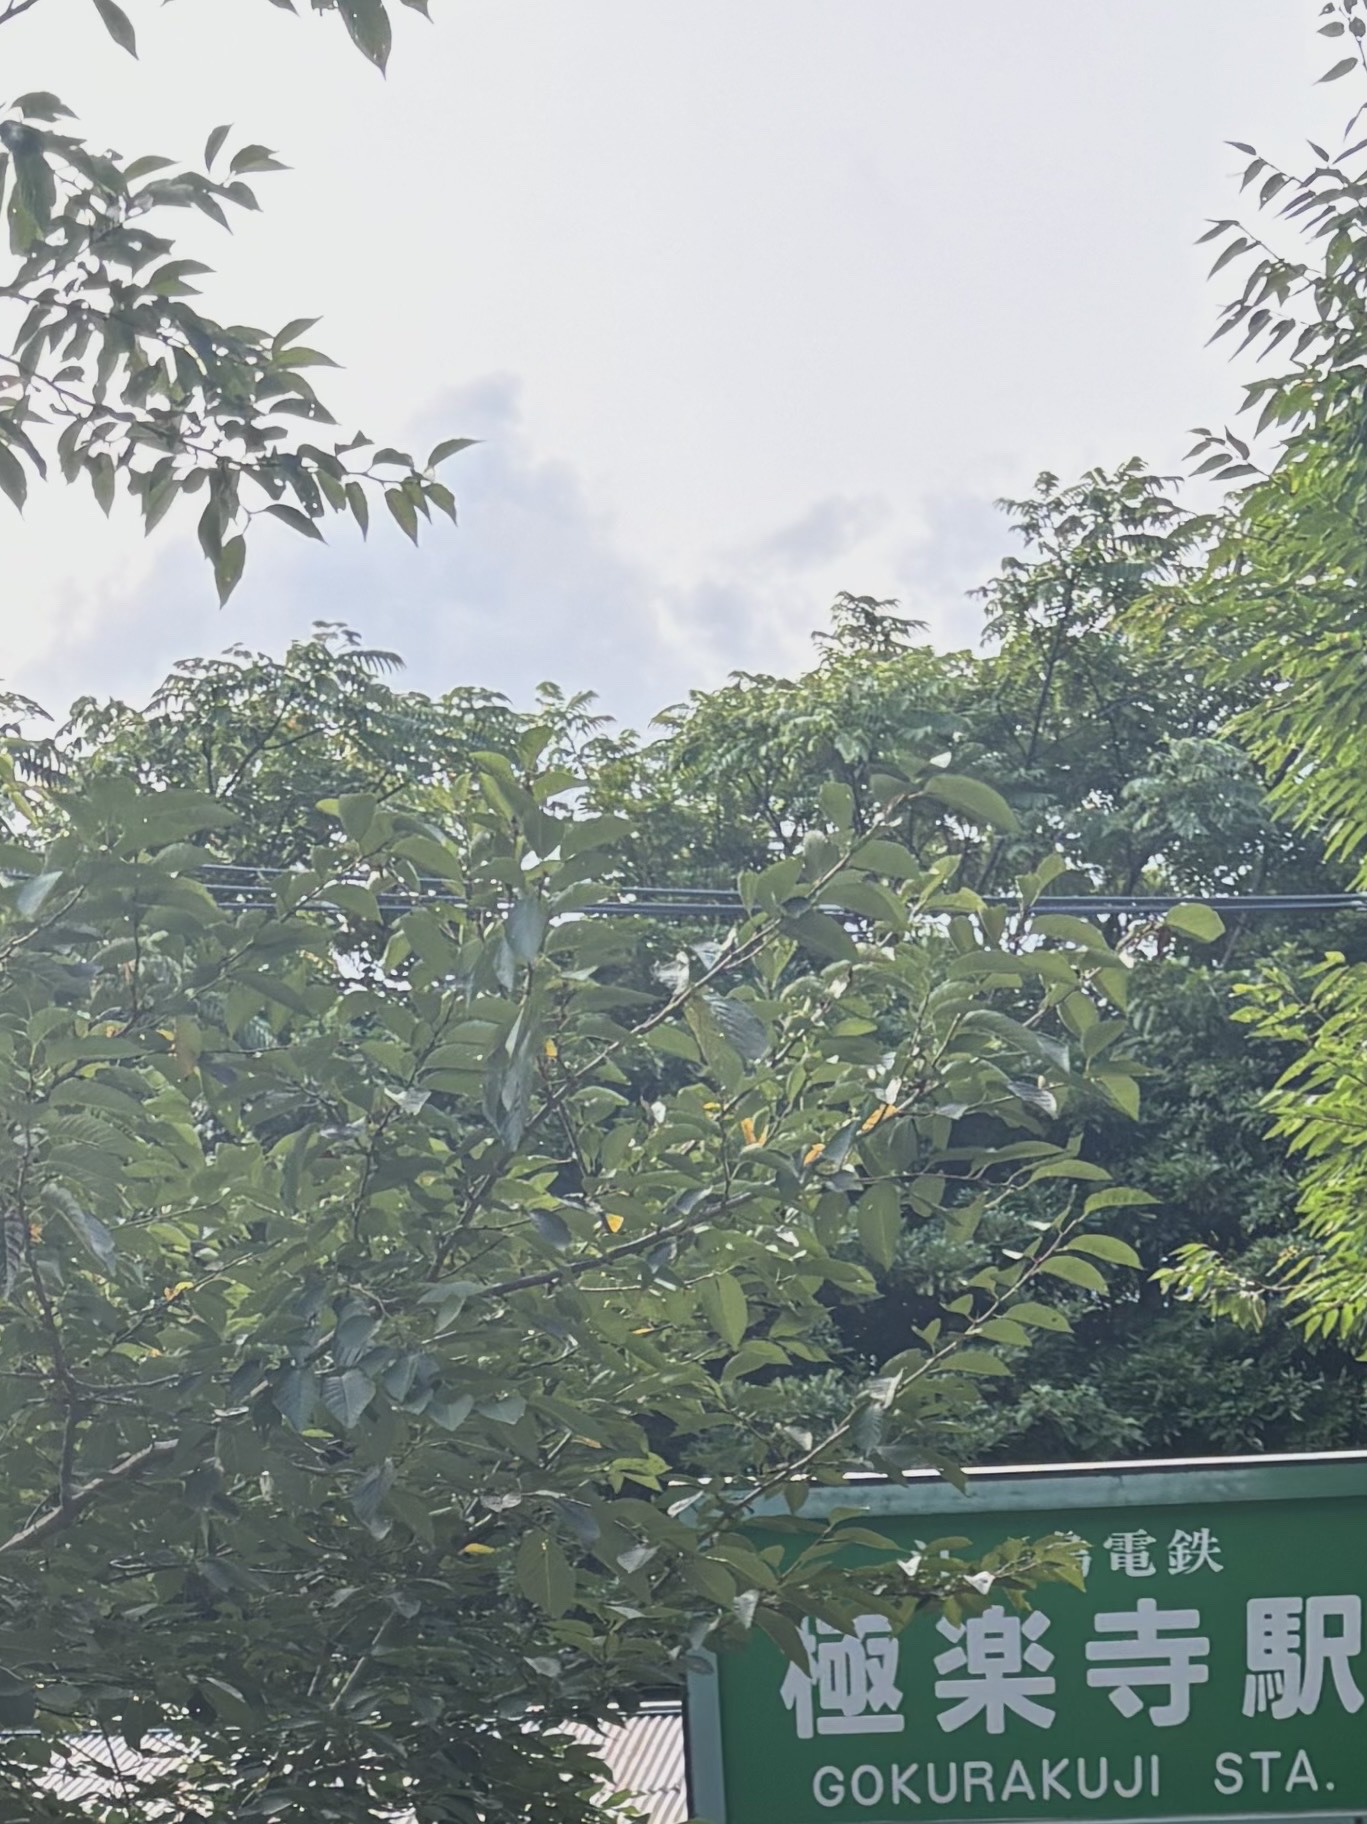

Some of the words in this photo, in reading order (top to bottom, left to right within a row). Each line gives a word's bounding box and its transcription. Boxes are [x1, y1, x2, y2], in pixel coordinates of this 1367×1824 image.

[779, 1594, 1366, 1740] 極楽寺駅
[812, 1754, 1160, 1807] GOKURAKUJI
[1213, 1748, 1336, 1796] STA.
